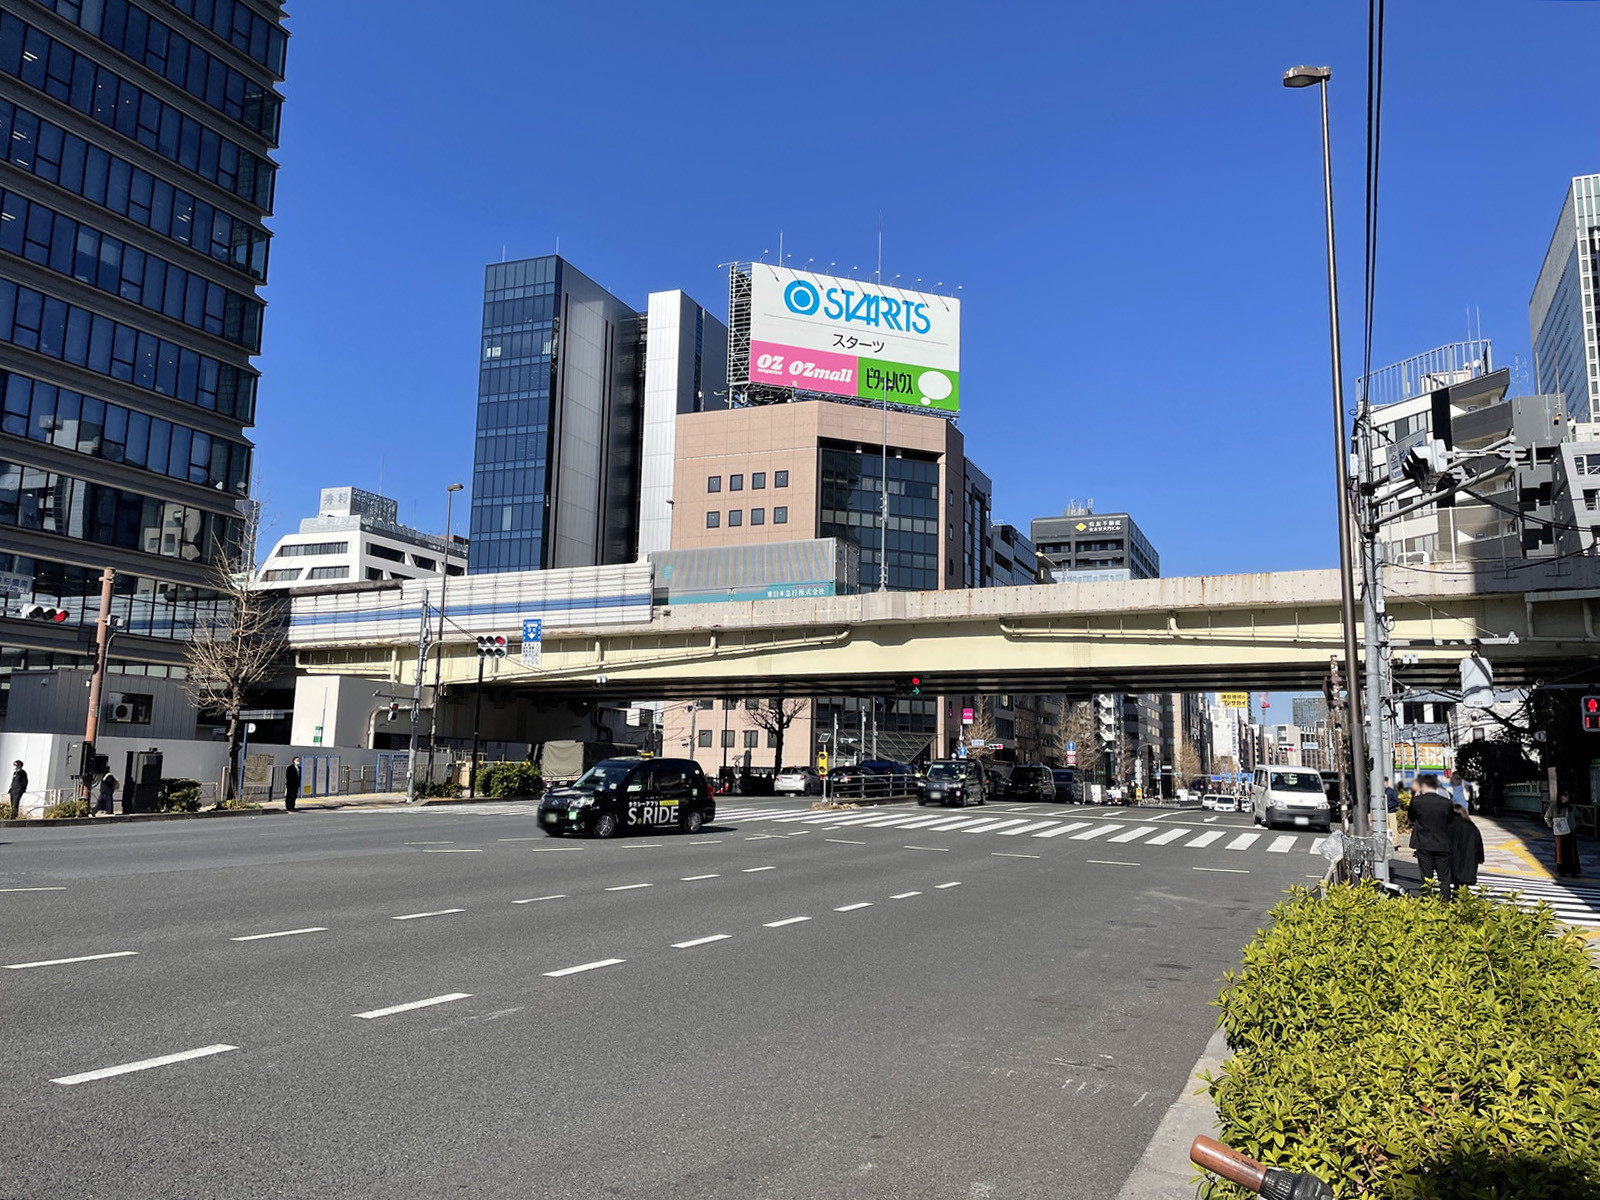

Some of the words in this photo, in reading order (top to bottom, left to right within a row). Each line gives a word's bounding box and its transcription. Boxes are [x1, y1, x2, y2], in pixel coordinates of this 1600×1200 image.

[832, 333, 885, 354] スターツ
[756, 353, 784, 371] OZ
[788, 360, 853, 383] OZmall
[767, 587, 825, 598] 東日本急行株式会社
[627, 806, 680, 826] S.RIDE
